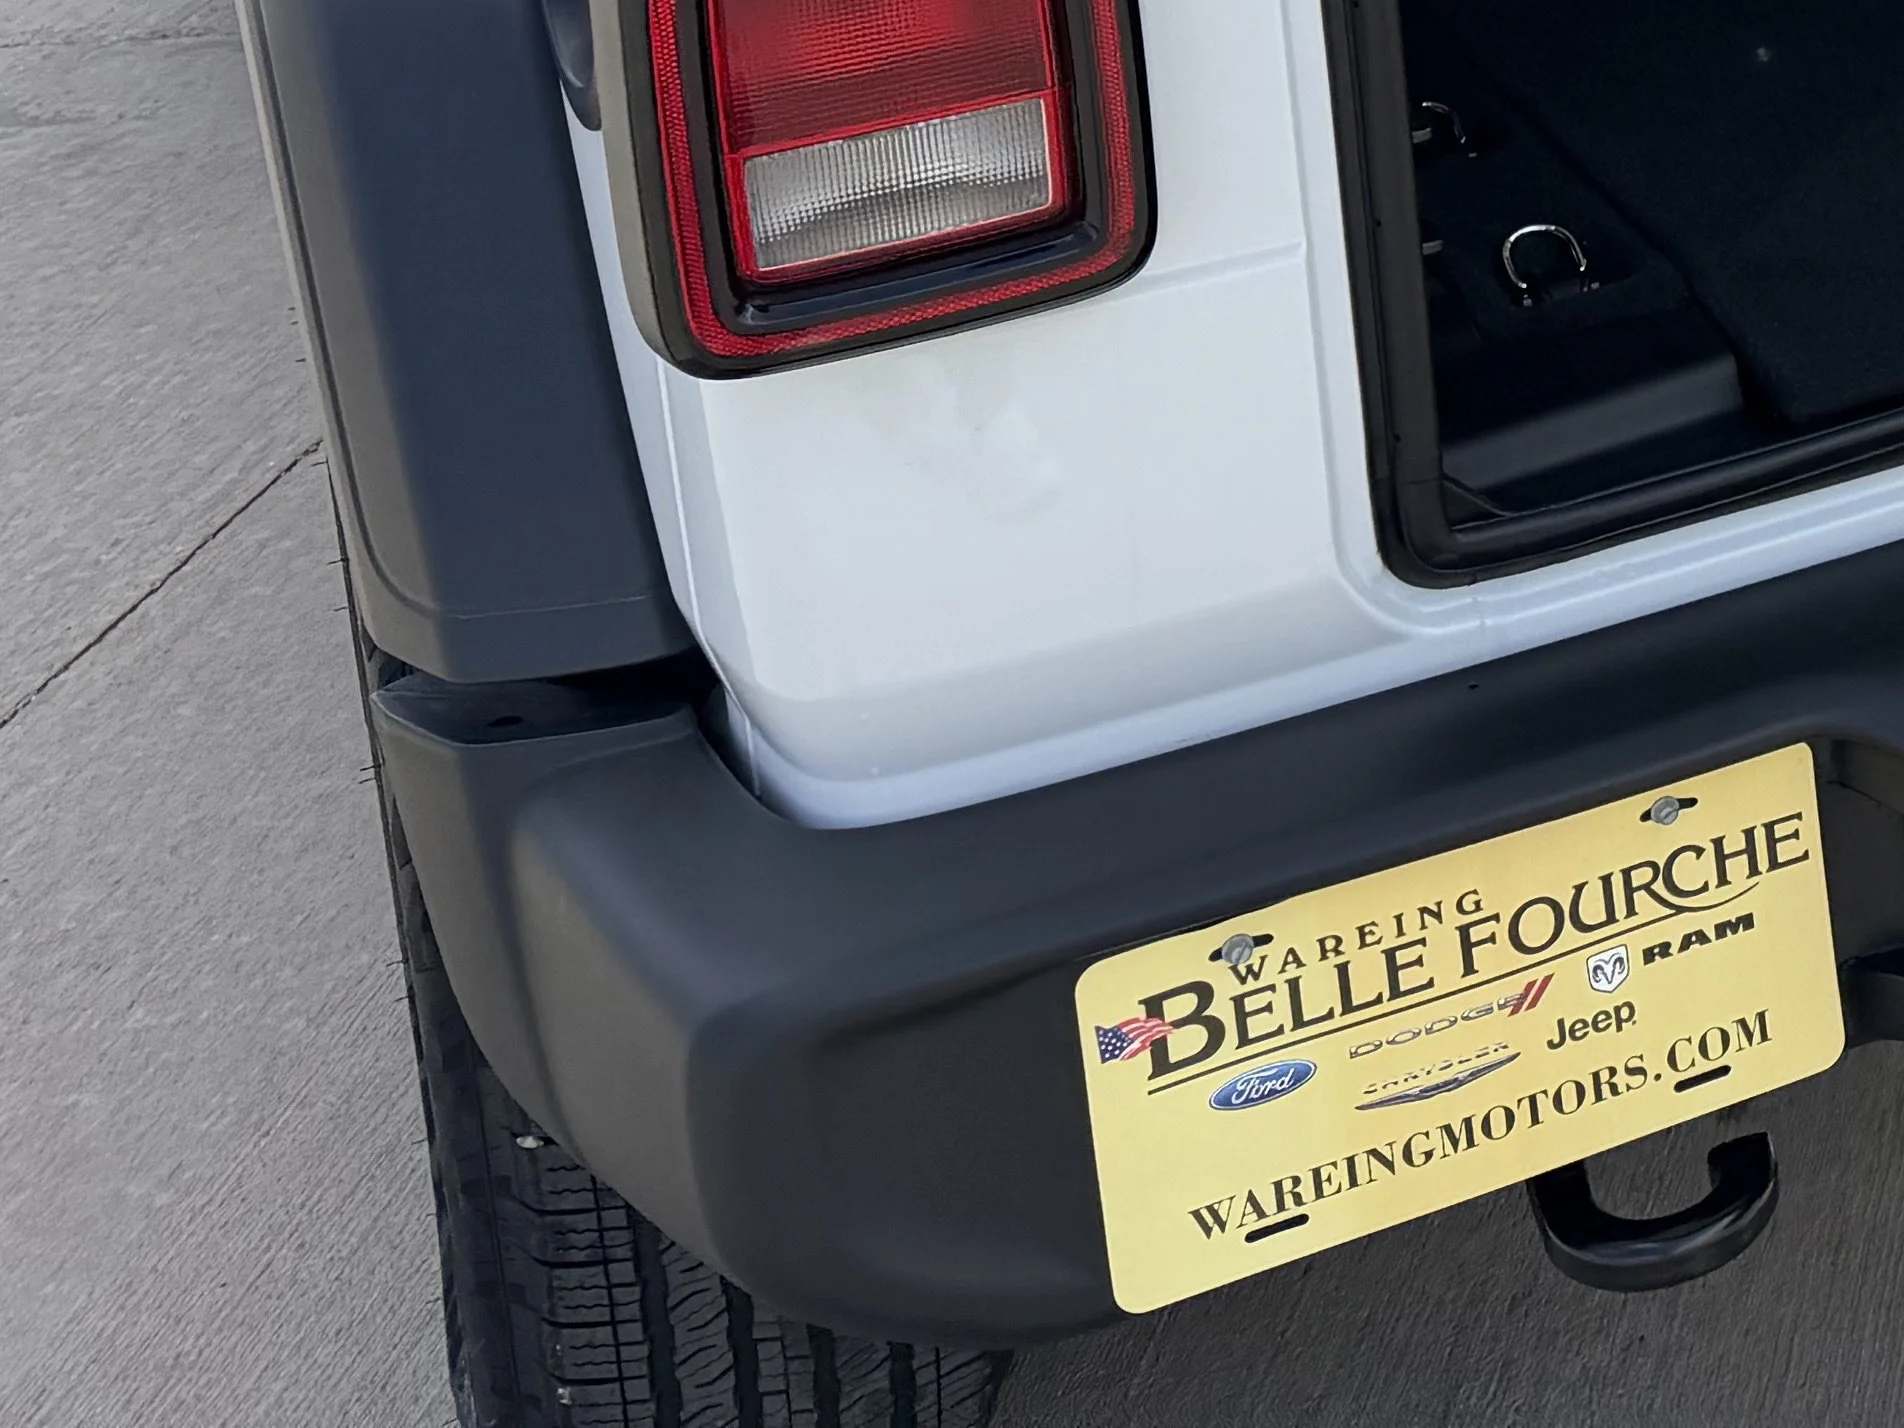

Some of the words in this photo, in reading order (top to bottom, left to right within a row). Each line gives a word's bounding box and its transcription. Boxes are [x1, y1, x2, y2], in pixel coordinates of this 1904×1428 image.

[1138, 936, 1436, 1081] BELLE
[1454, 811, 1811, 979] FOURCHE
[1228, 888, 1484, 986] WAREING
[1642, 911, 1755, 966] RAM
[1348, 991, 1526, 1059] DODGE
[1546, 1001, 1637, 1050] Jeep
[1231, 1068, 1296, 1104] Ford
[1361, 1041, 1510, 1095] CHRYSLER
[1187, 1007, 1773, 1243] WAREINGMOTORS.COM
